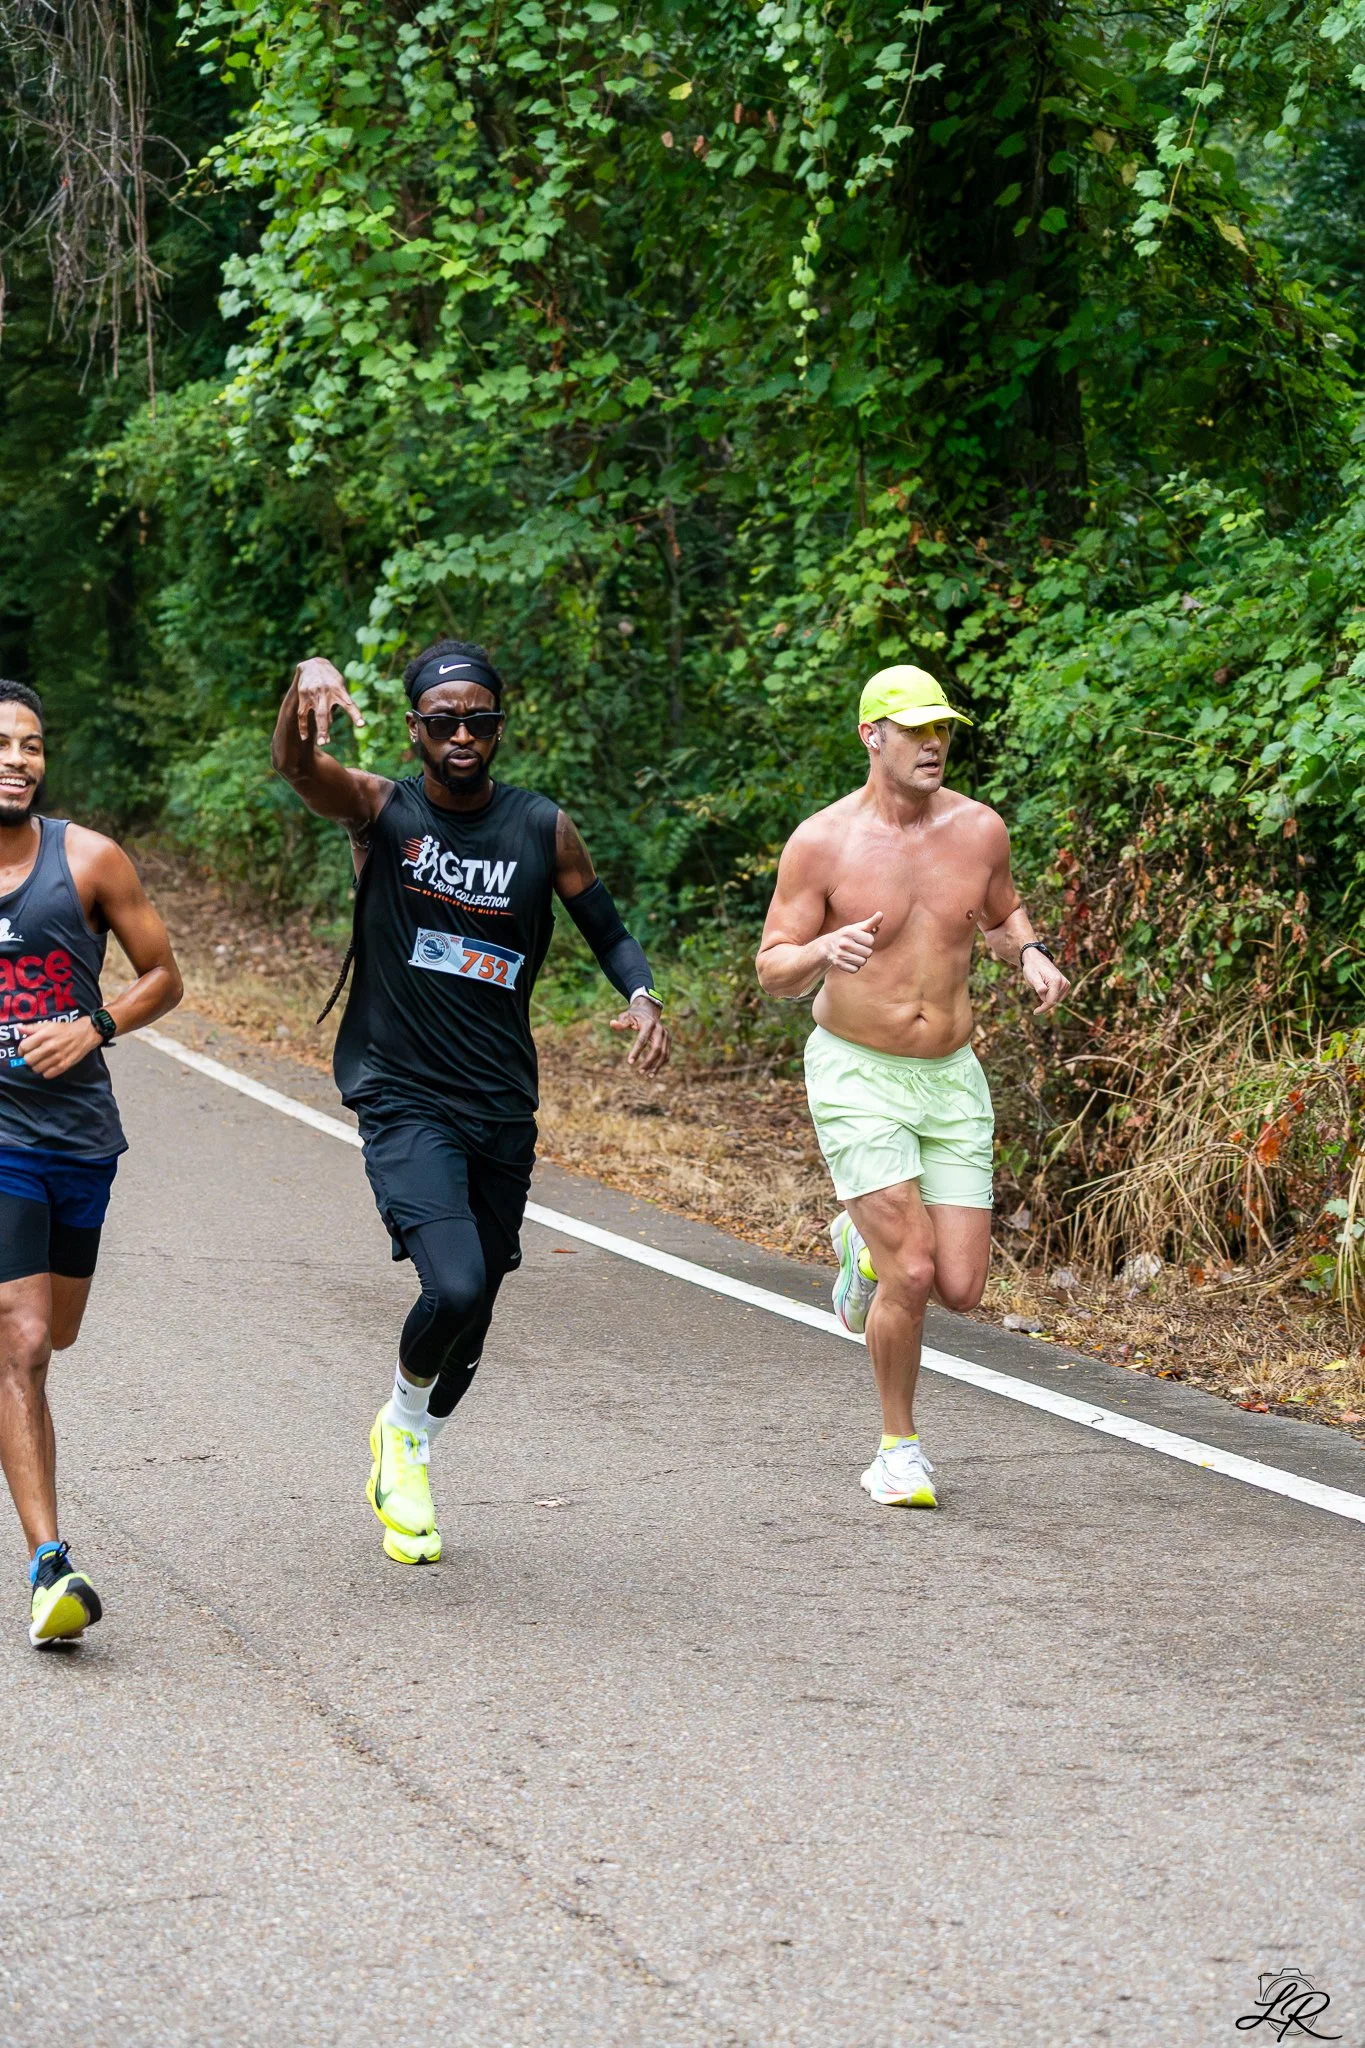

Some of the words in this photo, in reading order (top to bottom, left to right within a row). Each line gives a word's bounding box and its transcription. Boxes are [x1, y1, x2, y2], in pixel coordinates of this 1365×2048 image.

[439, 852, 517, 893] GTW
[434, 880, 454, 896] RUN
[454, 889, 510, 908] COLLECTION
[459, 950, 508, 985] 752
